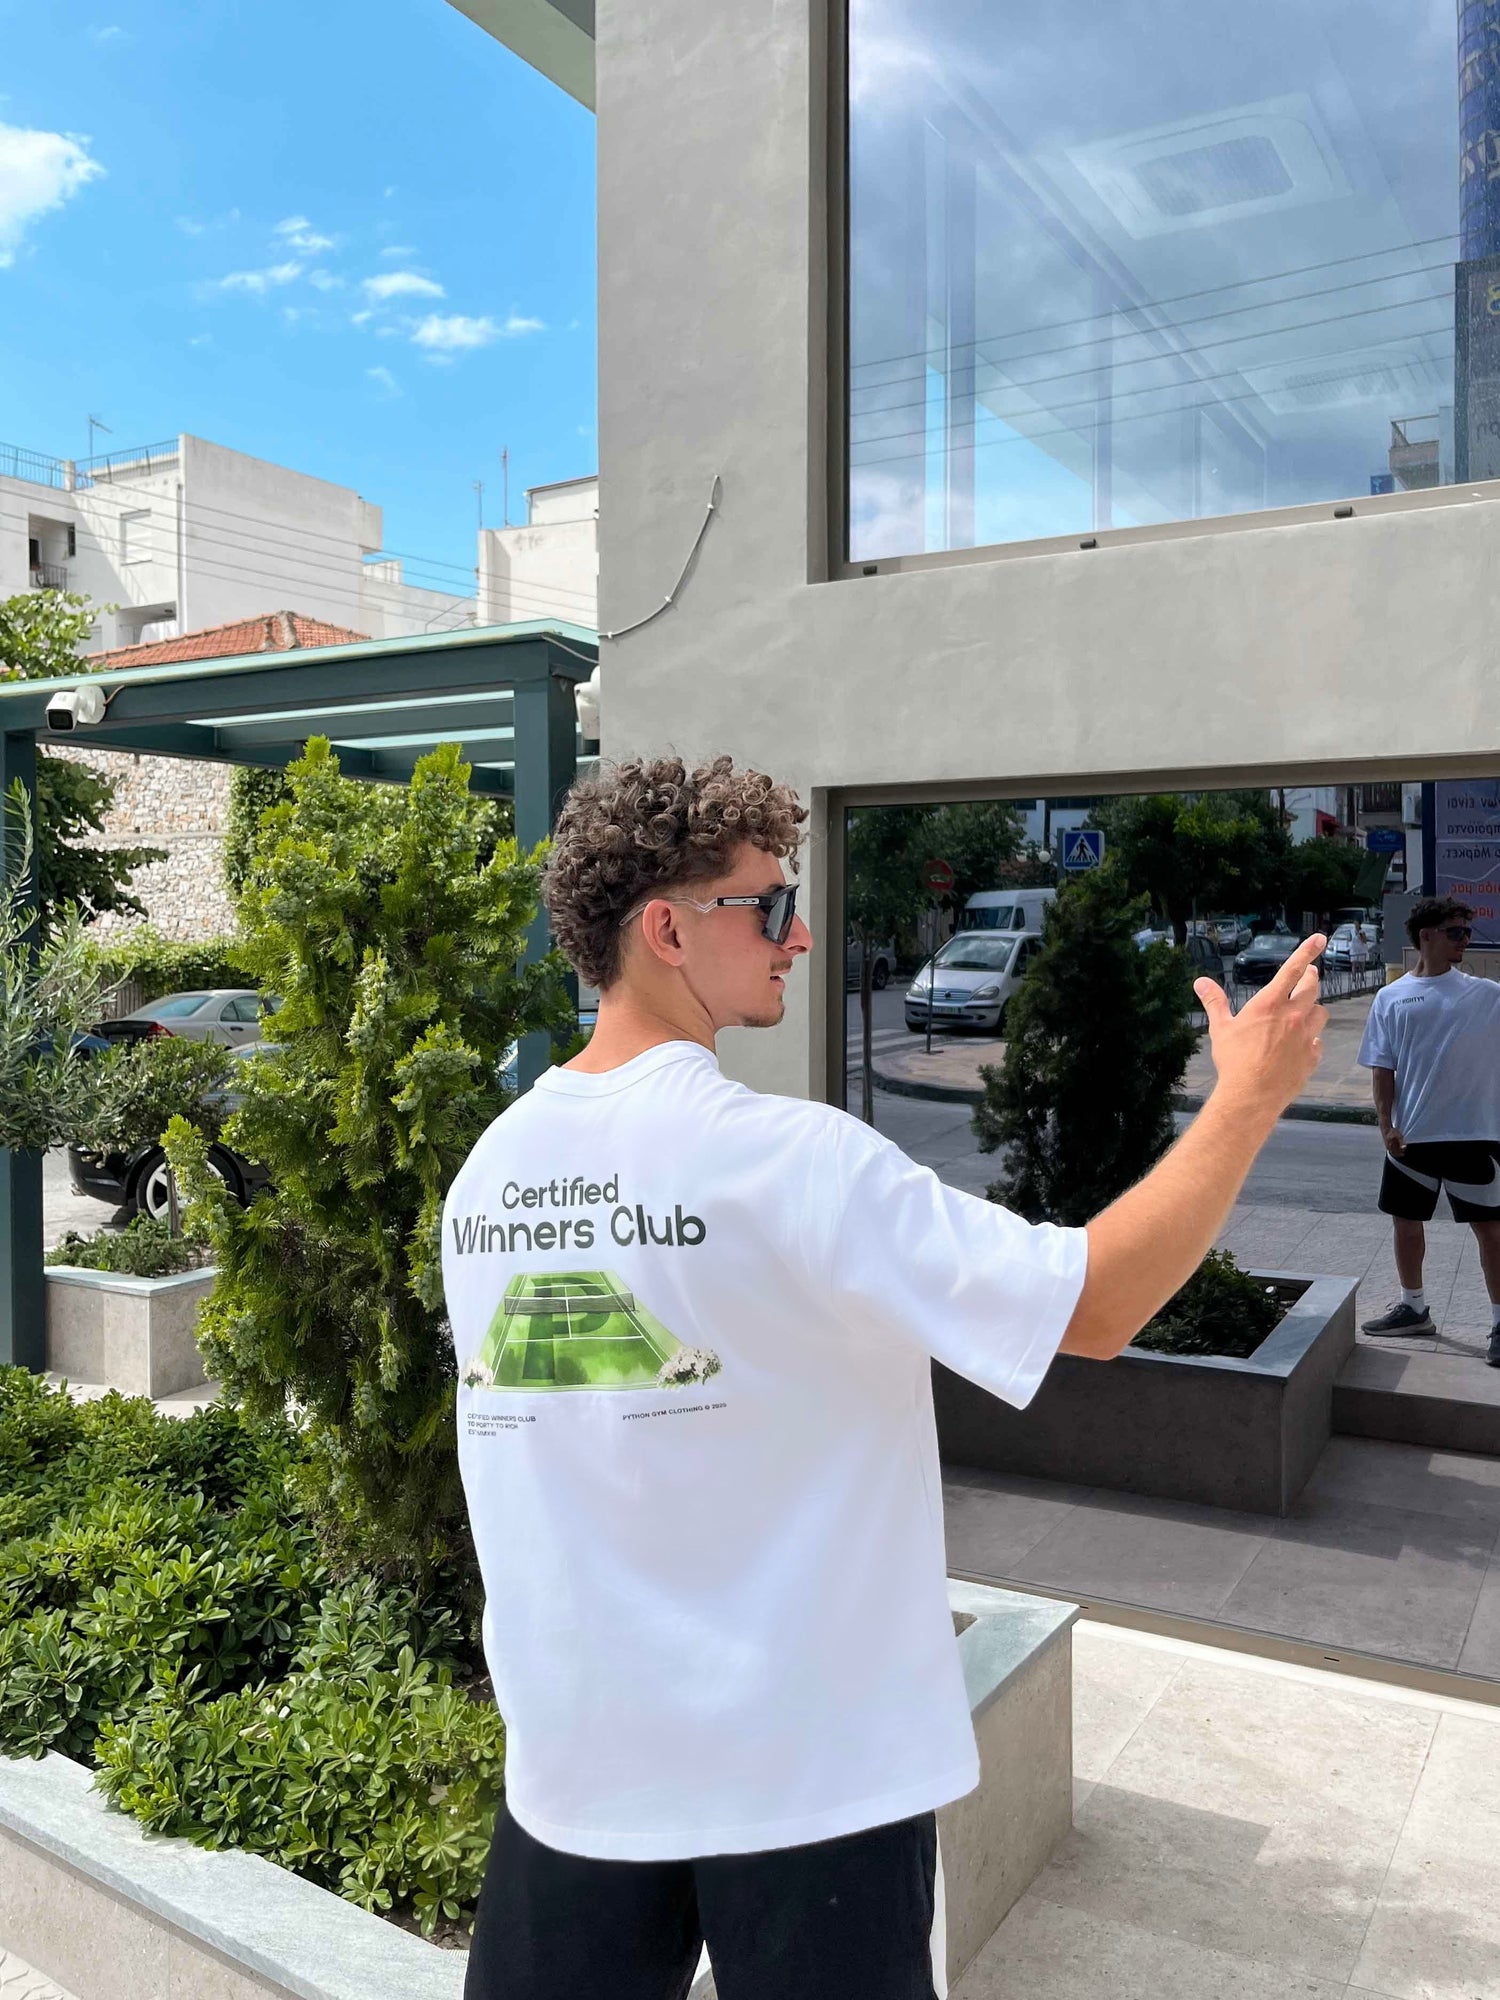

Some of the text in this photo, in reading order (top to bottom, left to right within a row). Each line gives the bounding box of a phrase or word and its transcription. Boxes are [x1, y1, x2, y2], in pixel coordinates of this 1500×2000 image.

[502, 1173, 619, 1209] Certified
[452, 1204, 707, 1255] Winners Club
[622, 1412, 650, 1420] PYTHON
[651, 1409, 667, 1417] GYM
[668, 1405, 703, 1414] CLOTHING
